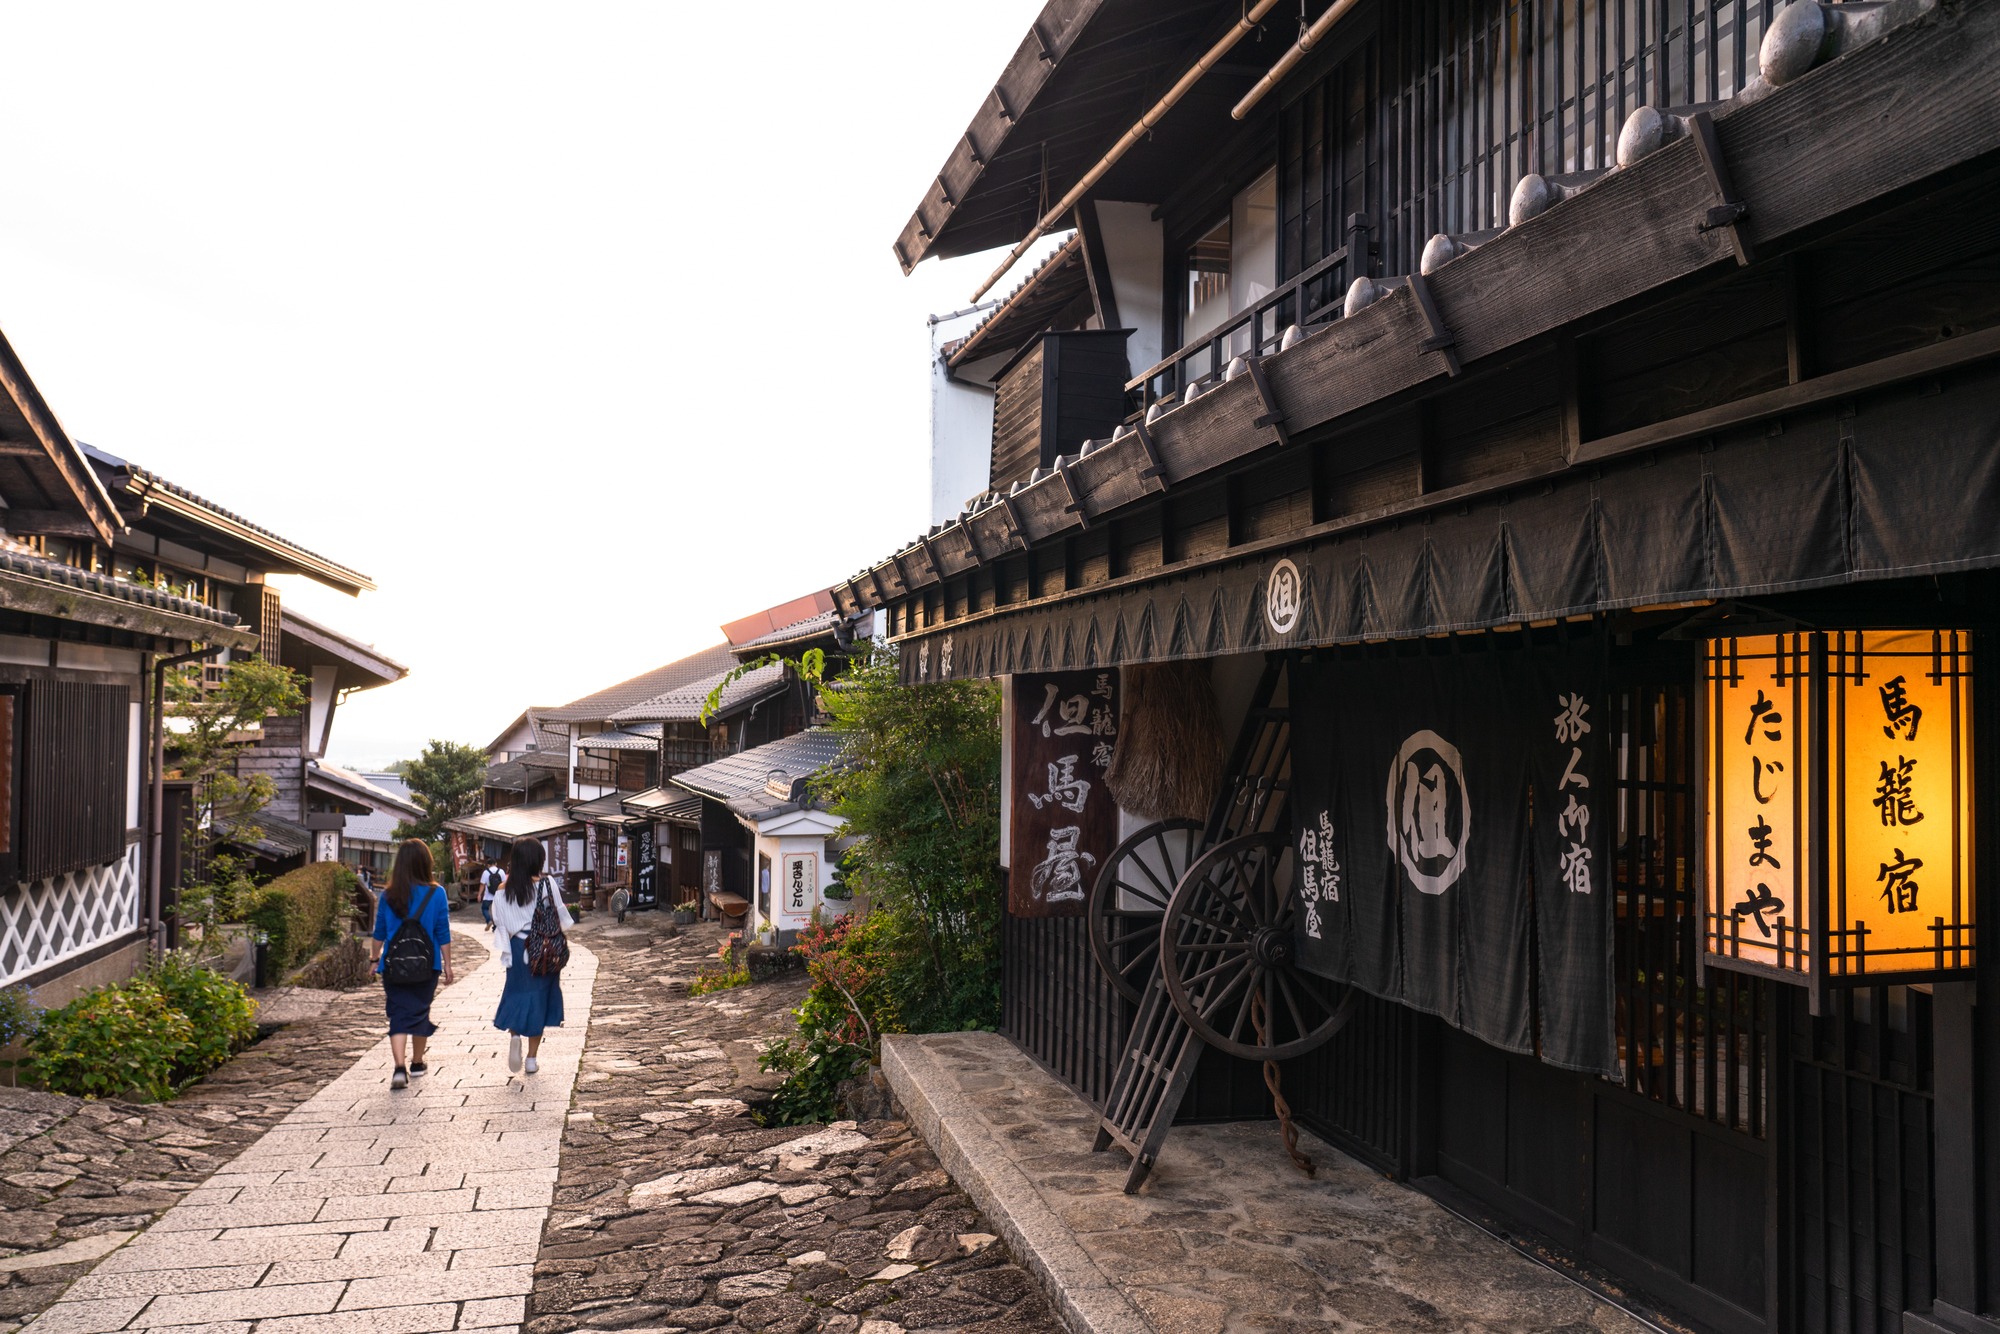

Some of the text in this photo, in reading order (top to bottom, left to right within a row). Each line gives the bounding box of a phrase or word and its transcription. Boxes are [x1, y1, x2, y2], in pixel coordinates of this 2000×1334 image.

[1026, 682, 1097, 903] 但馬屋
[1090, 673, 1118, 768] 馬籠宿
[1554, 692, 1592, 895] 旅人御宿
[1872, 675, 1924, 914] 馬籠宿
[792, 860, 804, 908] 栗きんとん
[1300, 827, 1322, 939] 但馬屋
[1319, 810, 1341, 902] 馬籠宿
[1735, 689, 1785, 938] たじまや
